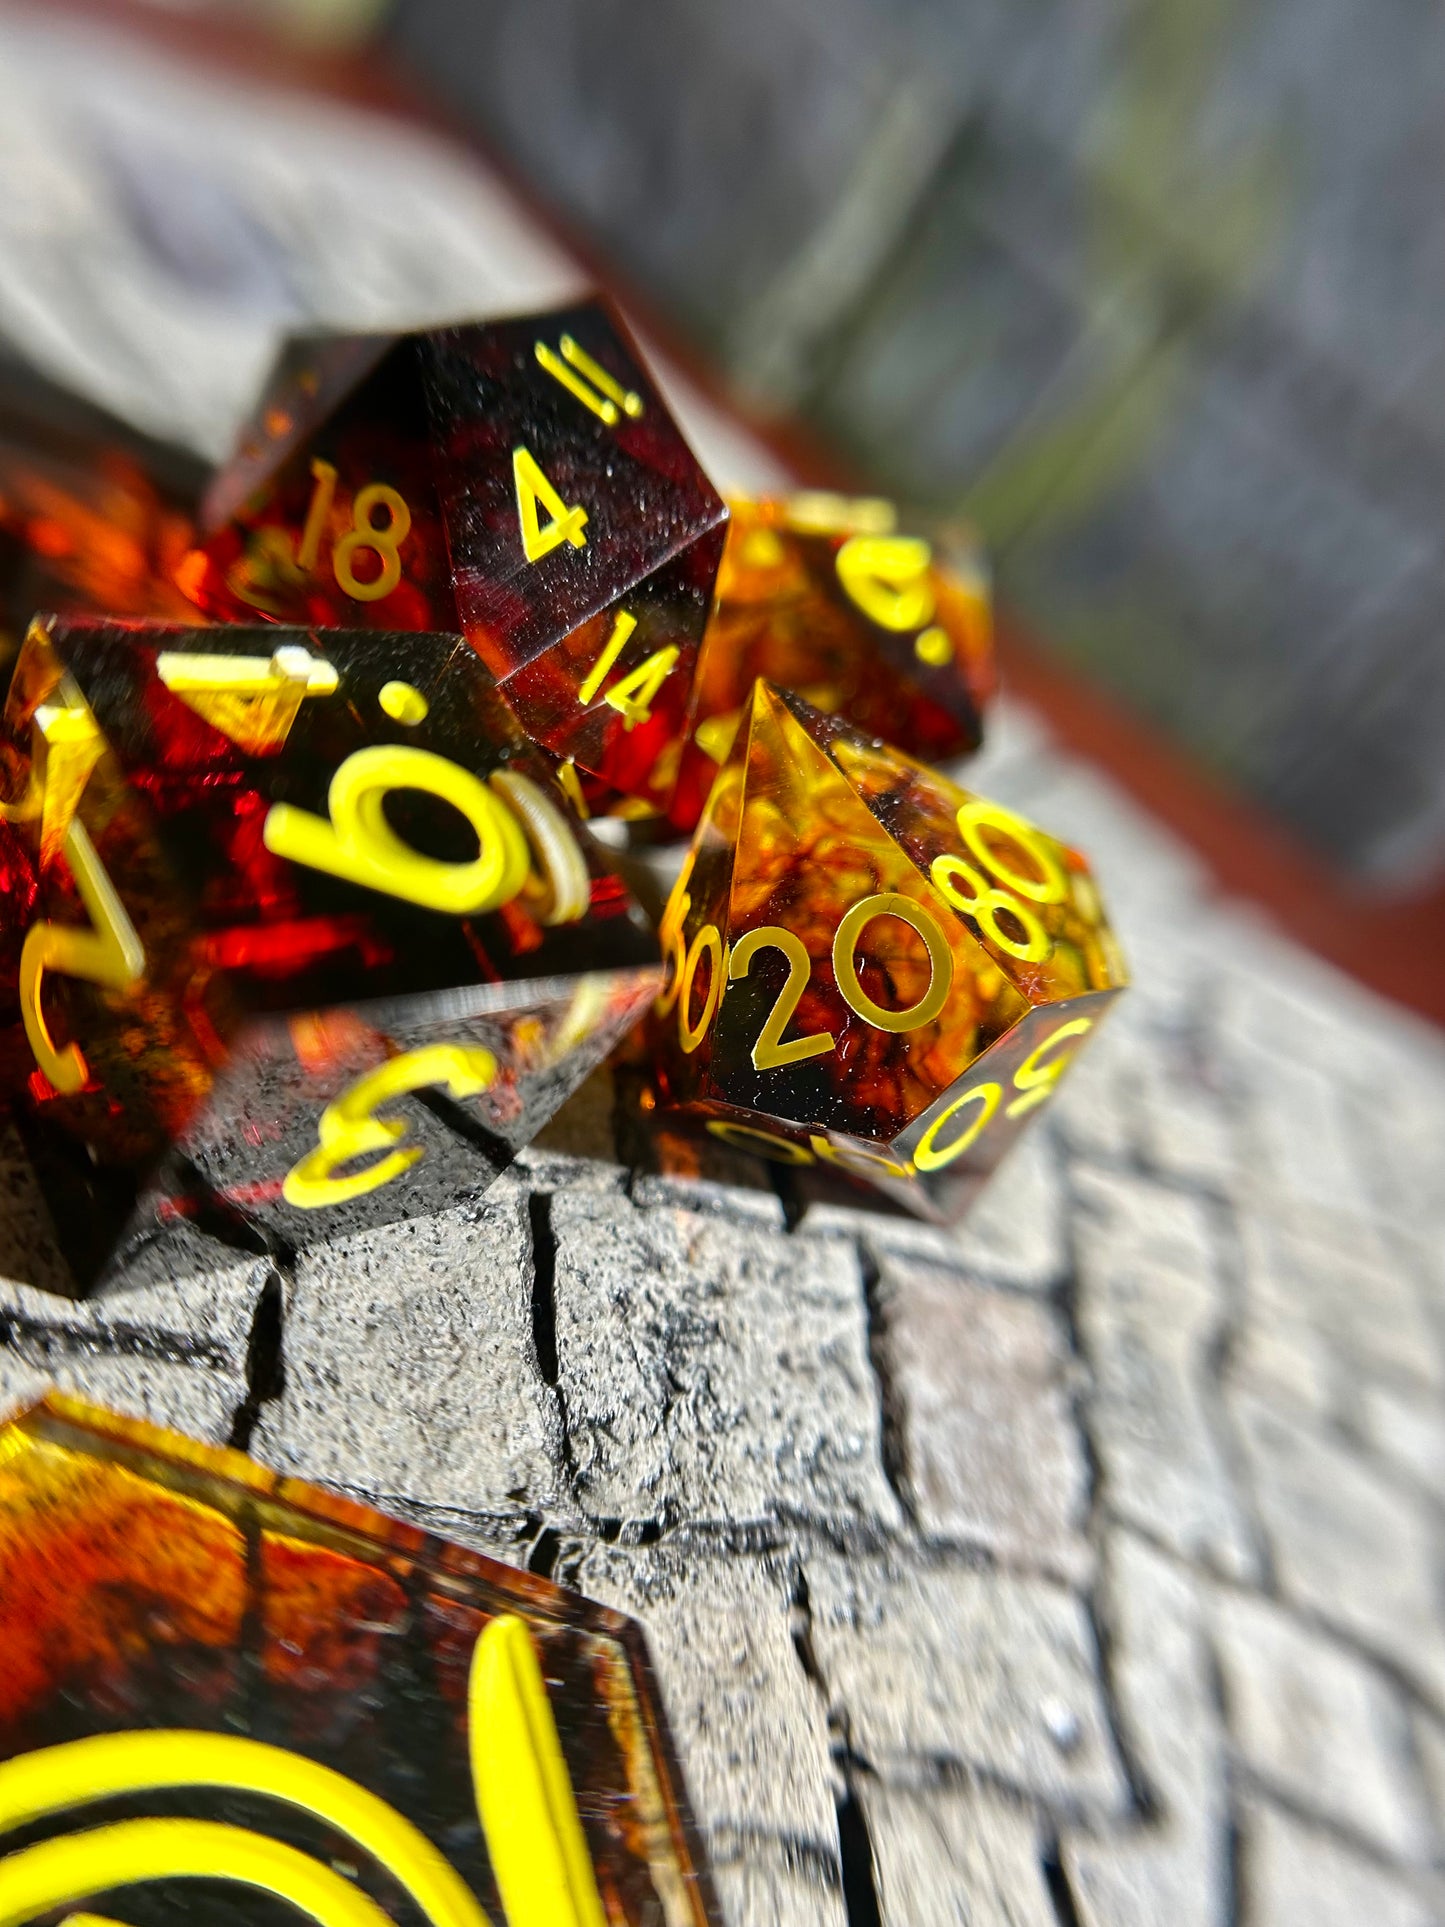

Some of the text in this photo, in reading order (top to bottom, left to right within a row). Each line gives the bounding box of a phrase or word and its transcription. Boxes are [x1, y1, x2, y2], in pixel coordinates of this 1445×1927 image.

[296, 456, 411, 601] 18
[513, 446, 588, 563] 4
[577, 610, 681, 732] 14
[930, 800, 1067, 963] 80
[728, 893, 953, 1071] 20
